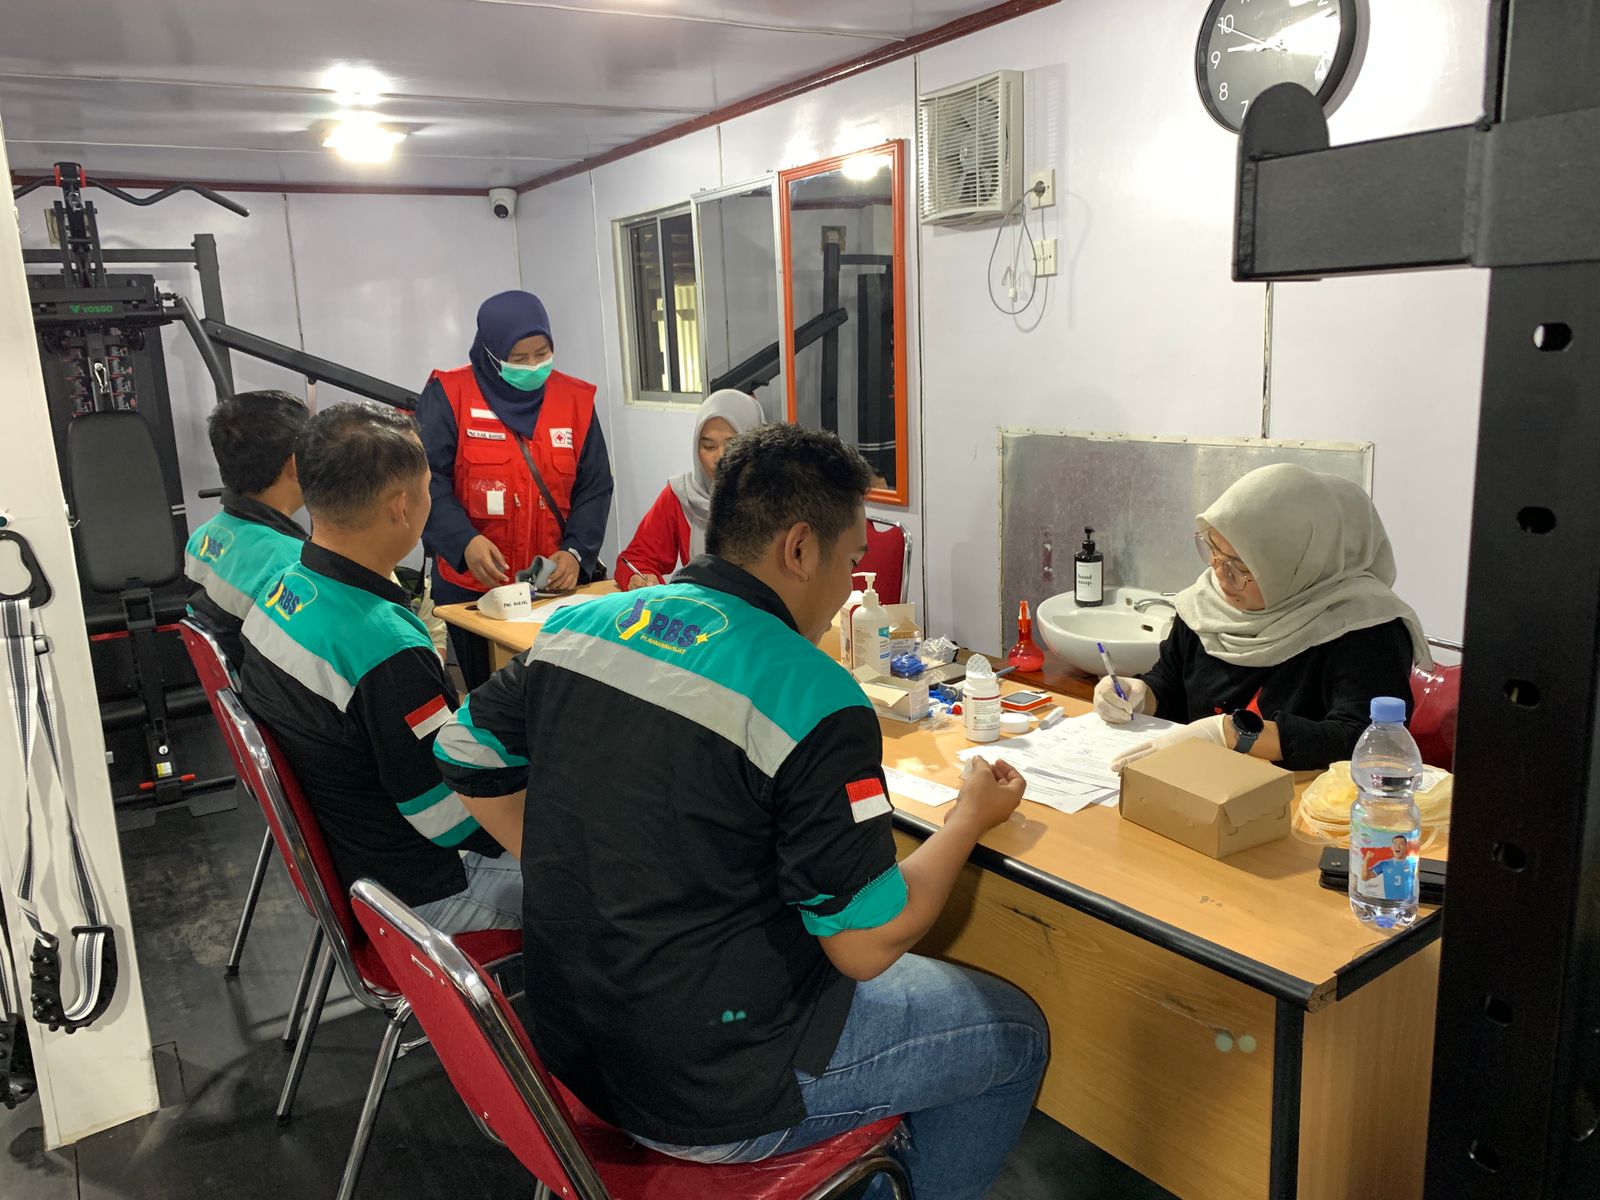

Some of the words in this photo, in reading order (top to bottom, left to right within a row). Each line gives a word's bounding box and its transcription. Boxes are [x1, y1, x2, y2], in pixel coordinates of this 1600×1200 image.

[1218, 14, 1234, 35] 10
[1211, 51, 1221, 69] 9
[1219, 82, 1229, 100] 8
[1240, 100, 1249, 119] 7
[280, 585, 300, 615] RBS
[647, 613, 701, 647] RBS
[1394, 875, 1402, 886] 3
